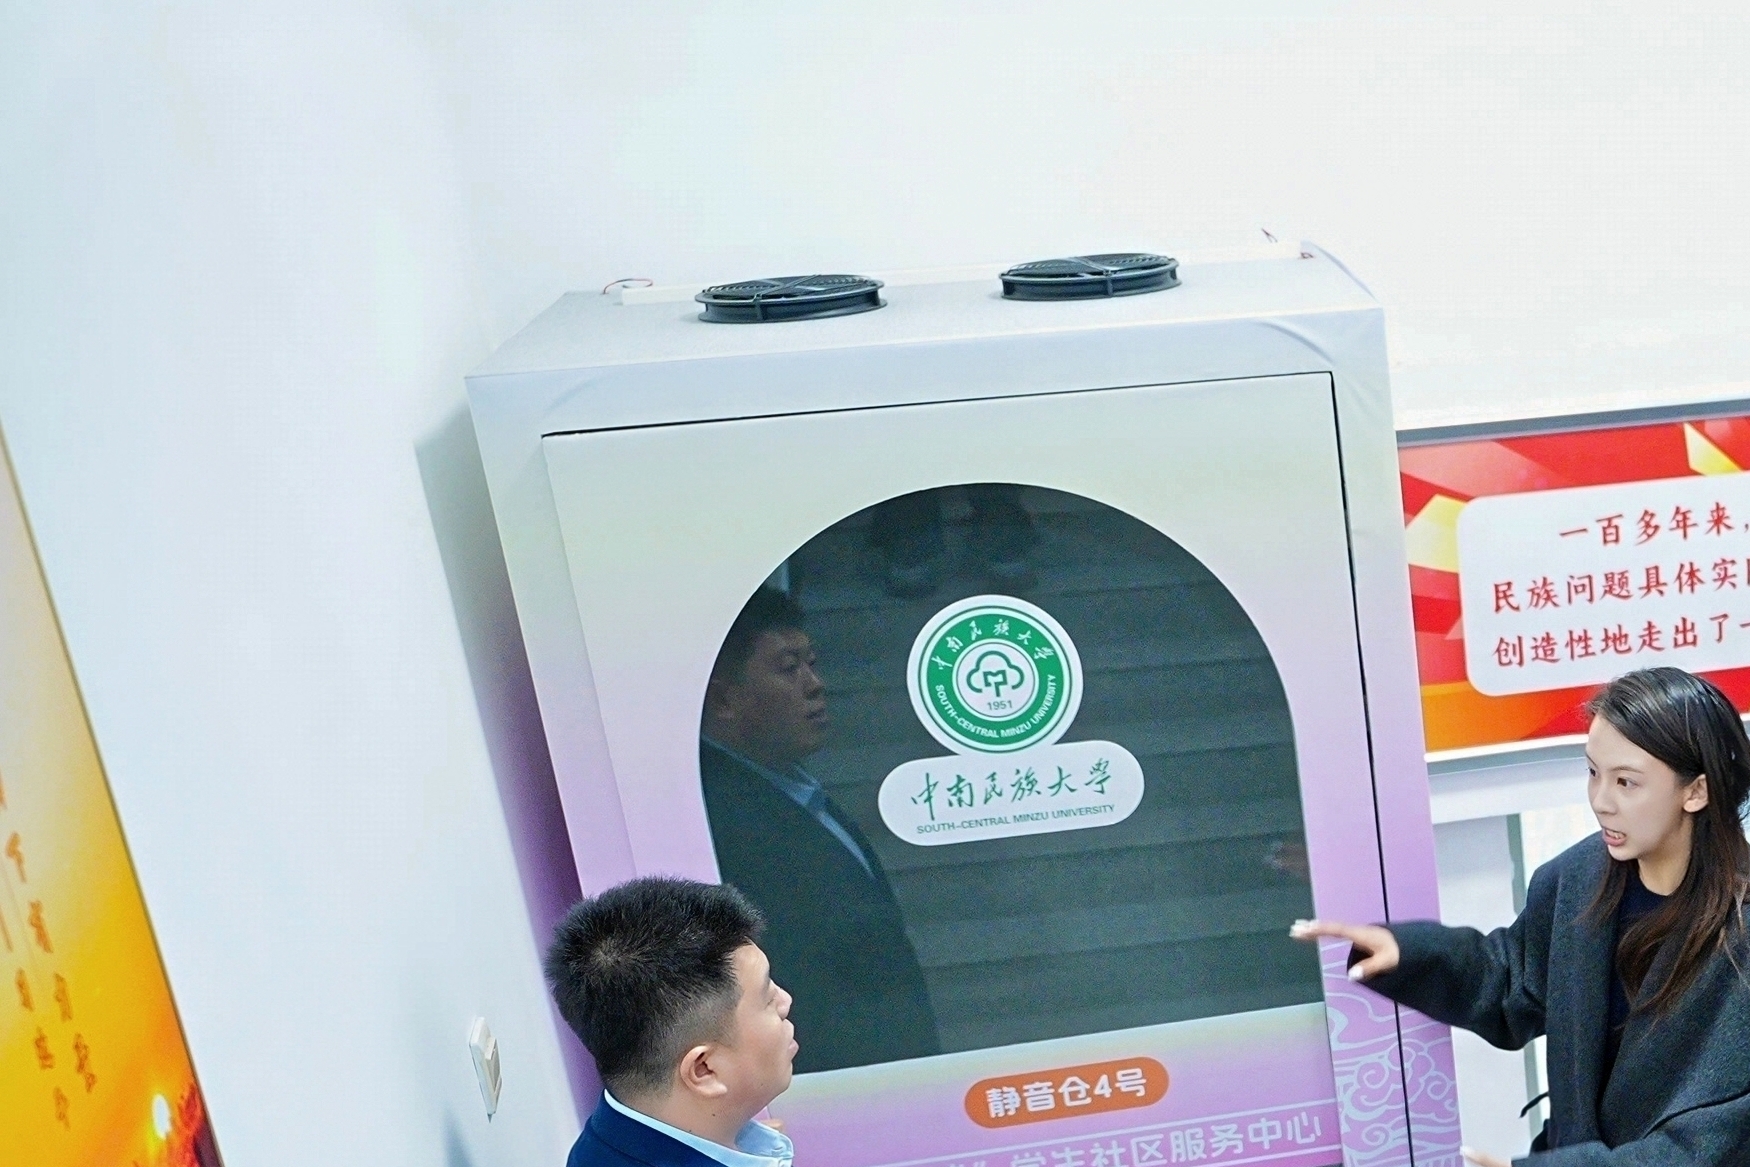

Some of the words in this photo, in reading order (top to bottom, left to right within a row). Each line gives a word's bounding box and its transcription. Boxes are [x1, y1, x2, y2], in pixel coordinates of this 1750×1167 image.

[935, 684, 1000, 738] SOUTH-CENTRAL
[1000, 721, 1032, 738] MINZU
[1030, 674, 1057, 725] UNIVERSITY
[987, 700, 1013, 711] 1951
[916, 816, 1009, 834] SOUTH-CENTRAL
[1012, 811, 1049, 823] MINZU
[1051, 804, 1116, 819] UNIVERSITY
[985, 1066, 1147, 1118] 静音仓4号
